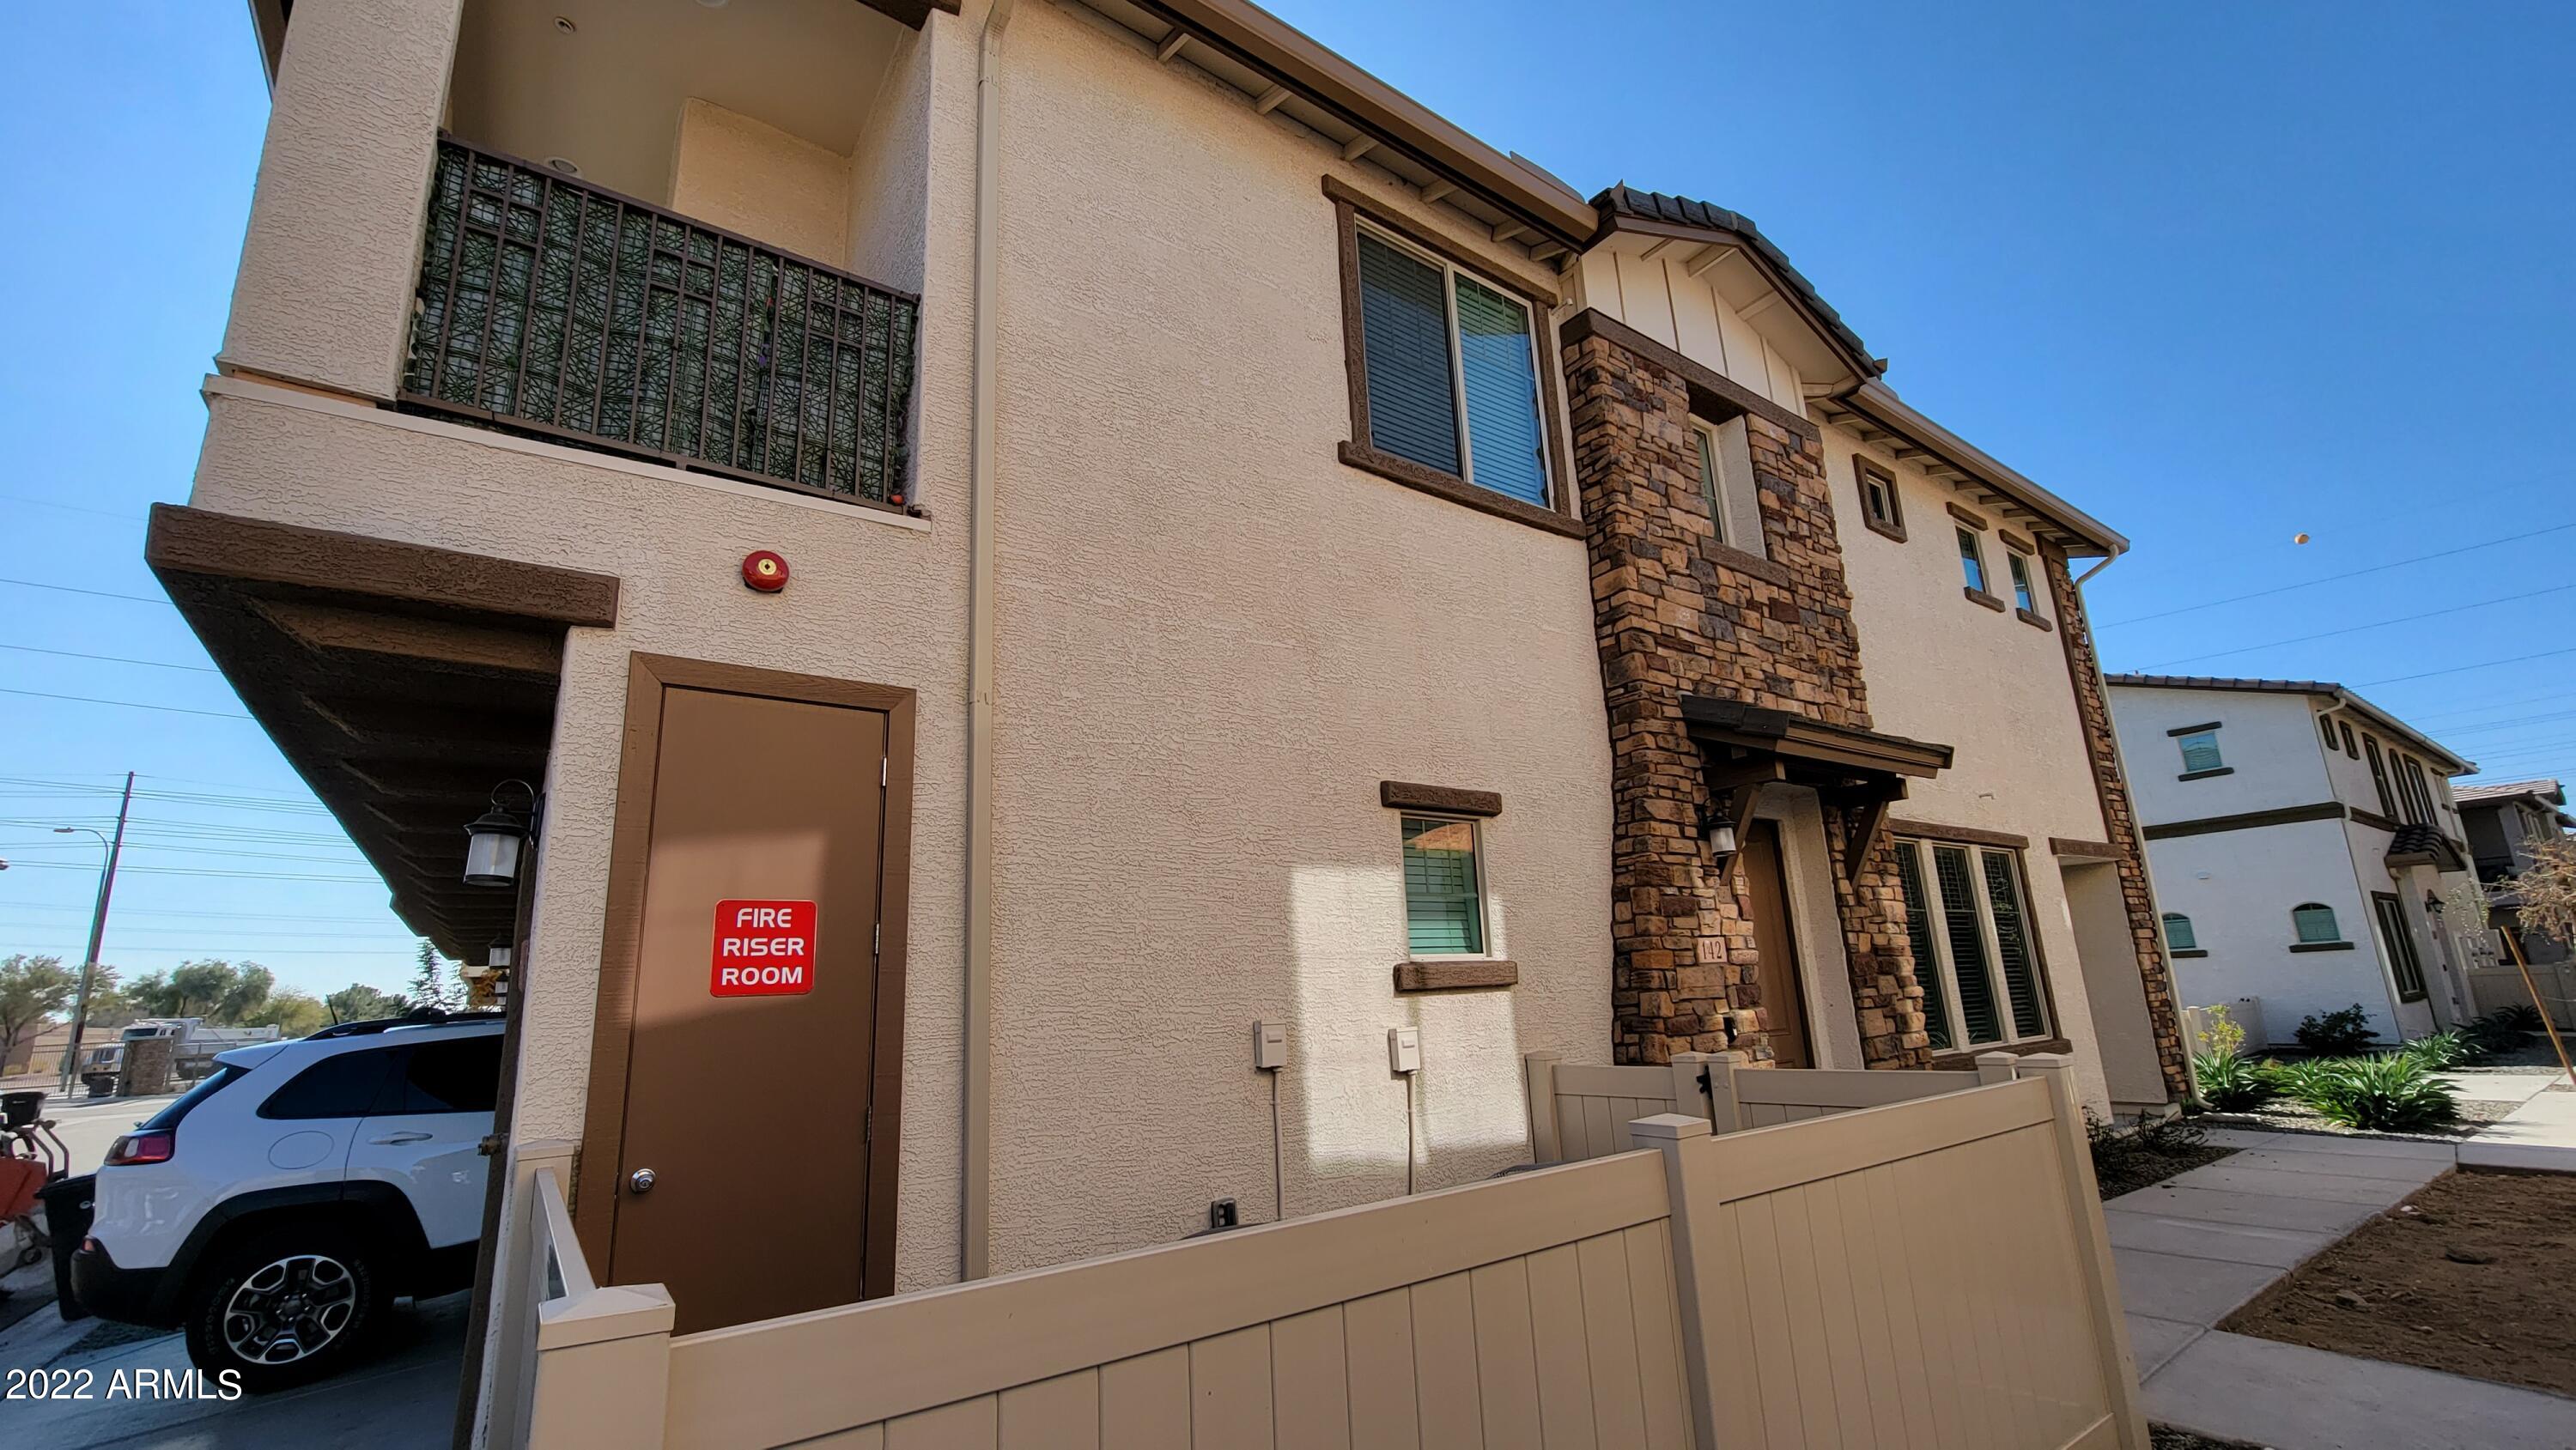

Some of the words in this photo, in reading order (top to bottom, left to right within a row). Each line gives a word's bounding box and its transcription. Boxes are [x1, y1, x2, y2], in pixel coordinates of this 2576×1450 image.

[737, 907, 793, 928] FIRE
[722, 937, 805, 957] RISER
[1702, 940, 1722, 960] 142
[721, 967, 803, 986] ROOM
